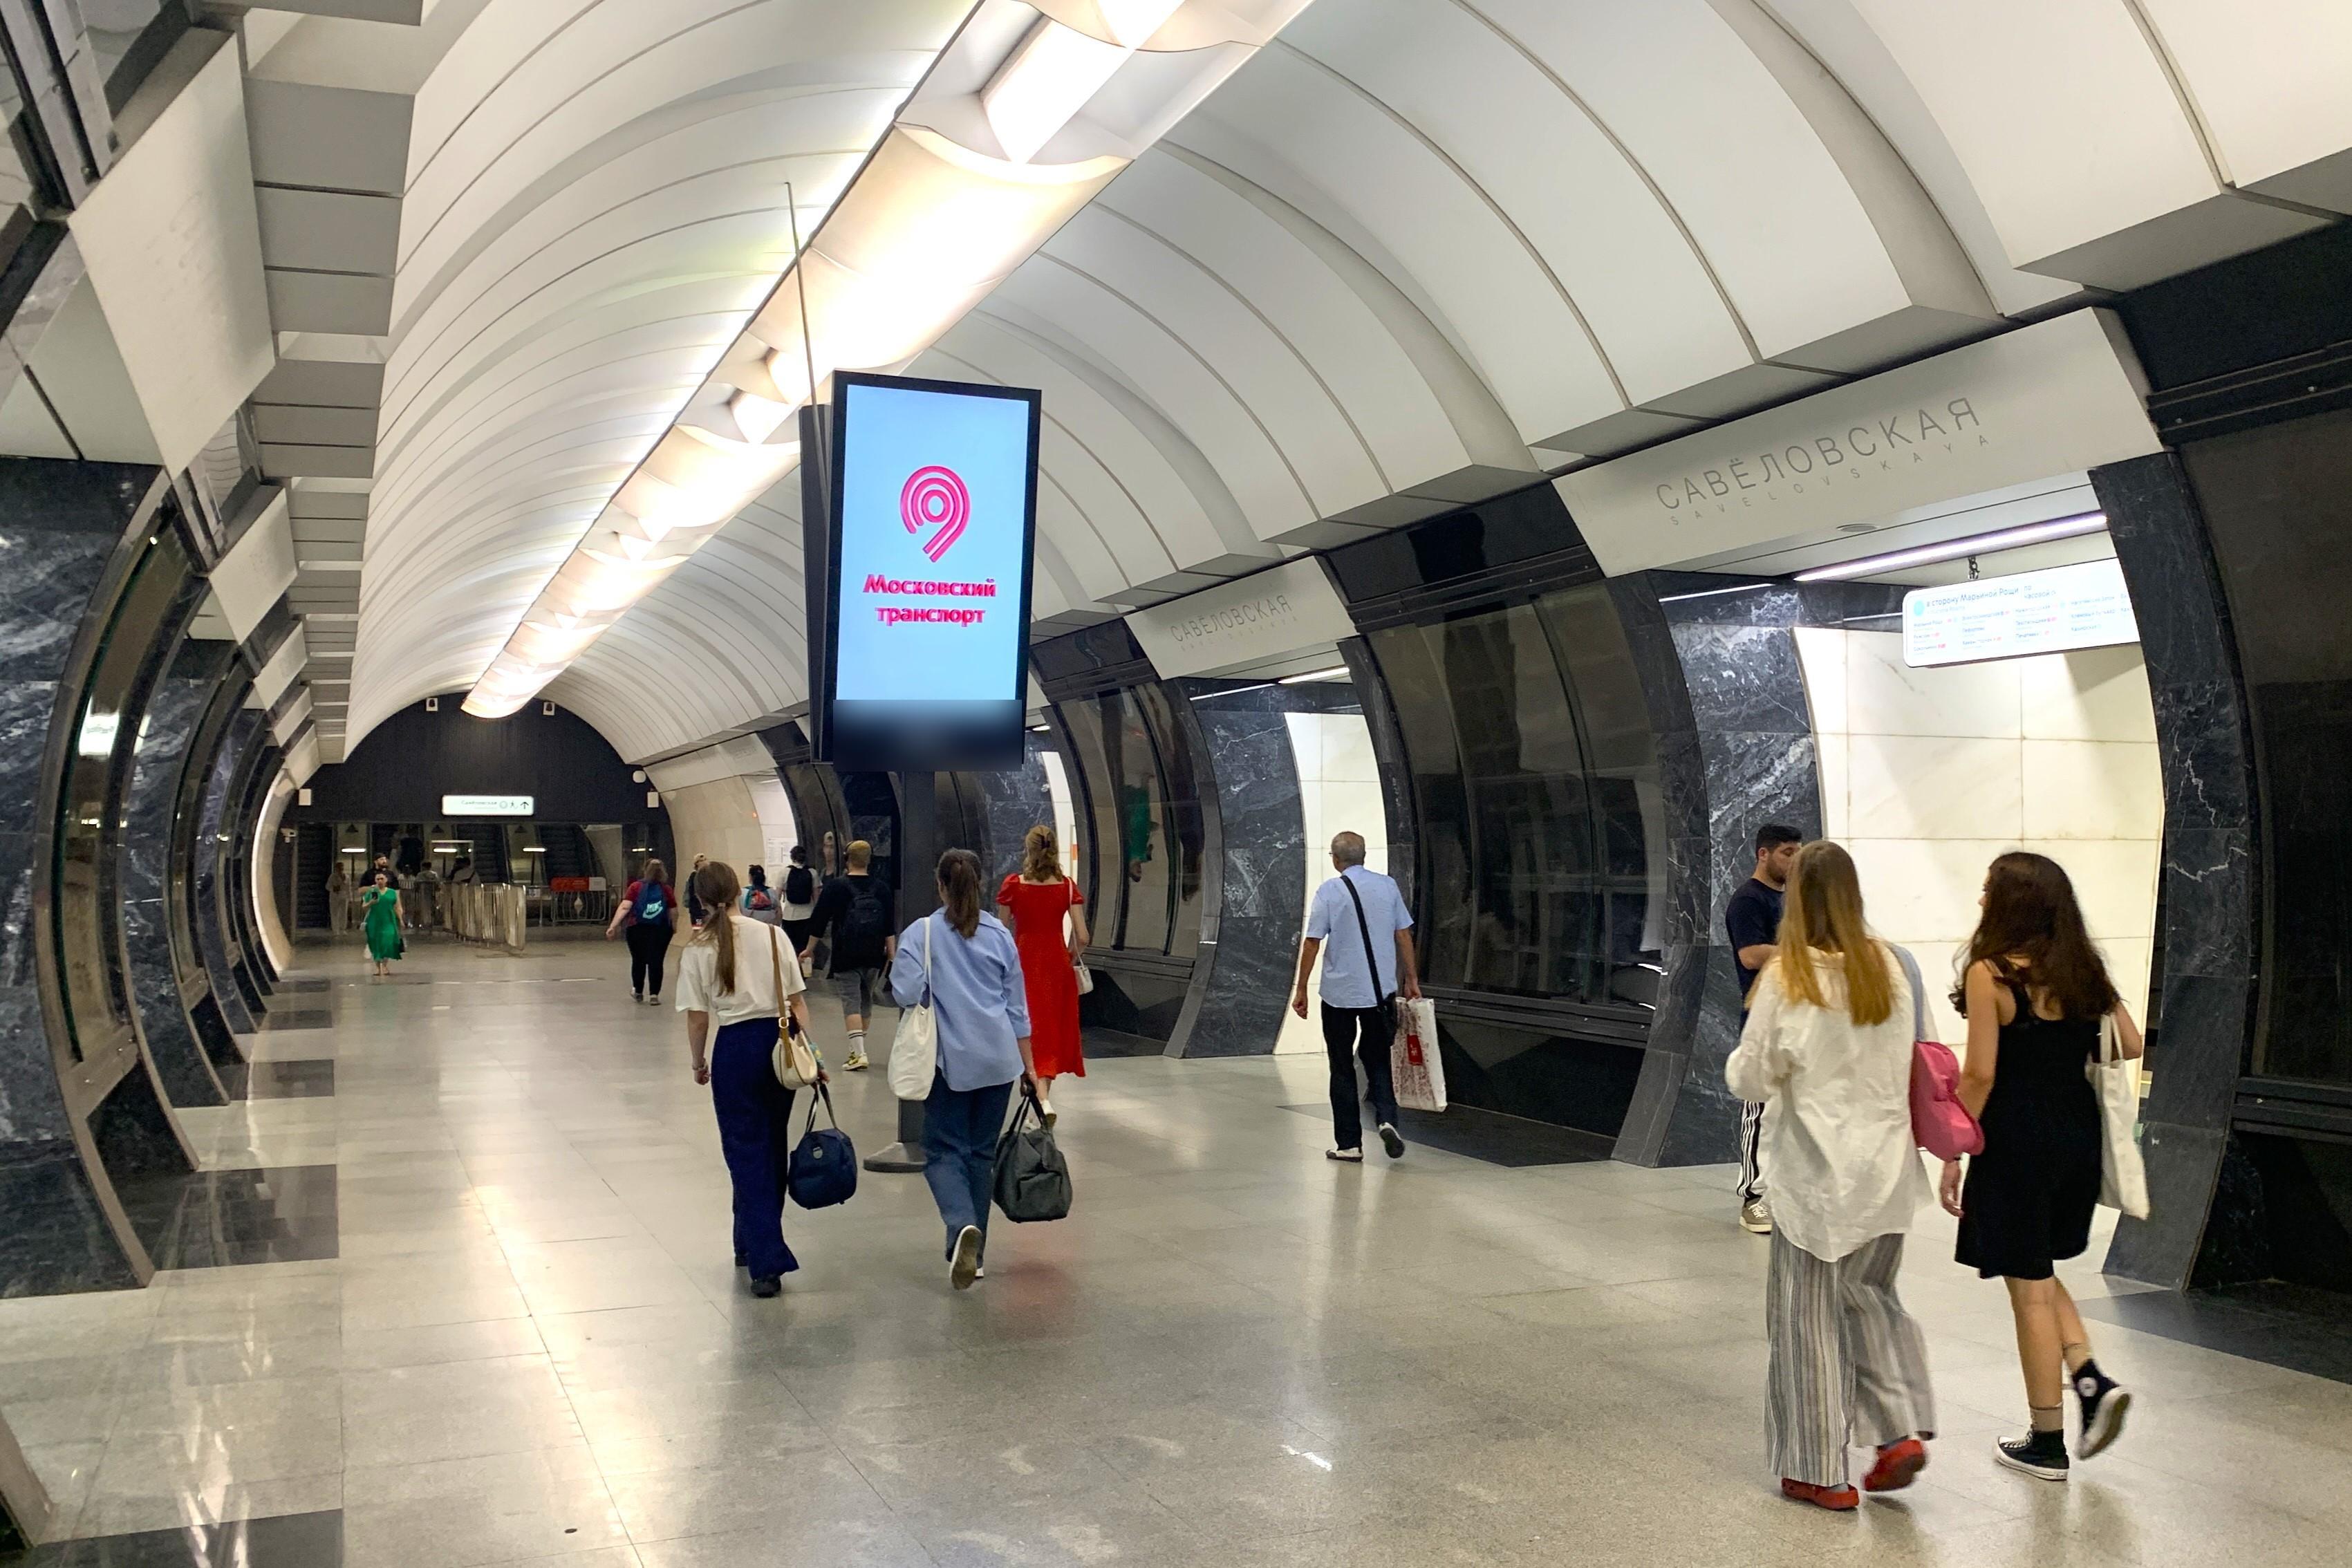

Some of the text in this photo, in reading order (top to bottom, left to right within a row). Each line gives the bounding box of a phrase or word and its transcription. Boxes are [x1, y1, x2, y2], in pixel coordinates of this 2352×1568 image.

[1656, 396, 1980, 510] САВЁЛОВСКАЯ
[1670, 434, 1990, 526] SAVELOVSKAYA
[862, 573, 997, 597] Московский
[875, 606, 986, 627] транспорт
[1170, 594, 1293, 642] САВЁЛОВСКАЯ
